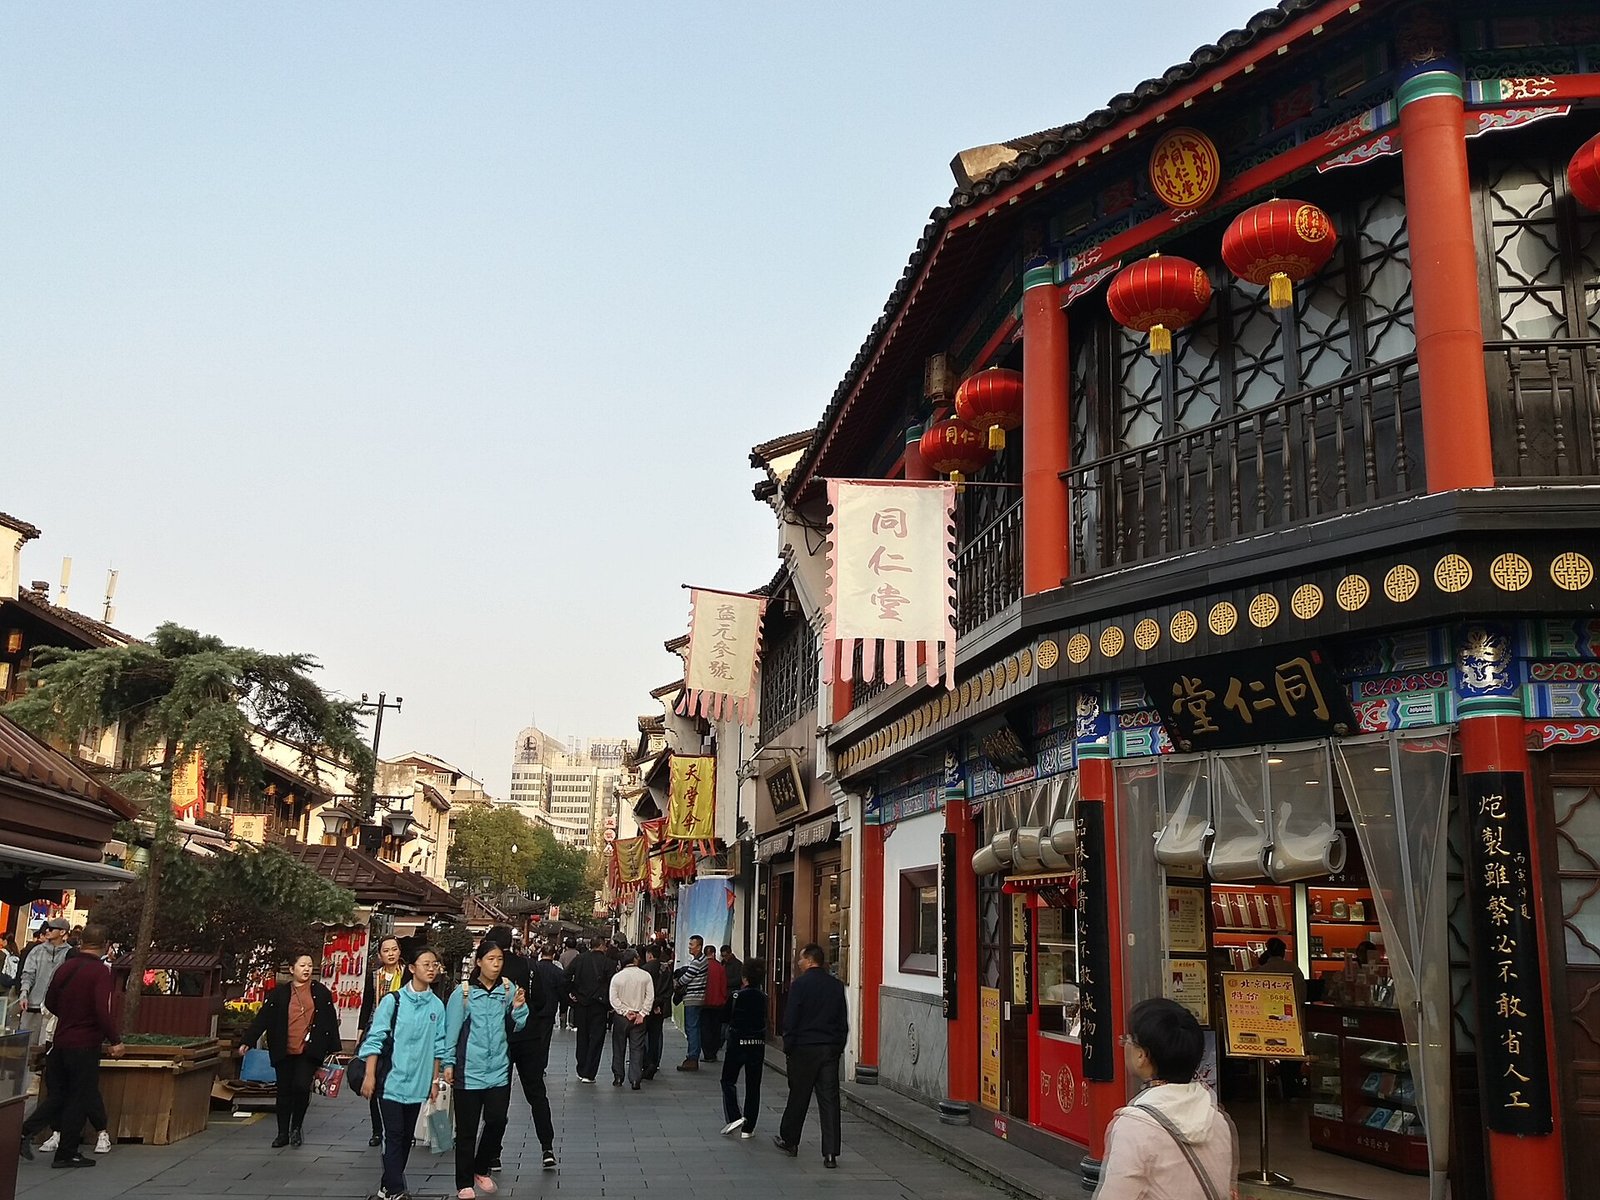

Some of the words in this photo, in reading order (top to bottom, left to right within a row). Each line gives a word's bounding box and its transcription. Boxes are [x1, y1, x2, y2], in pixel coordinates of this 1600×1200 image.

[1171, 147, 1195, 199] 同仁堂
[868, 508, 913, 622] 同仁堂
[1172, 656, 1330, 734] 同仁堂
[1478, 793, 1532, 1109] 炮製雖繁必不敢省人工
